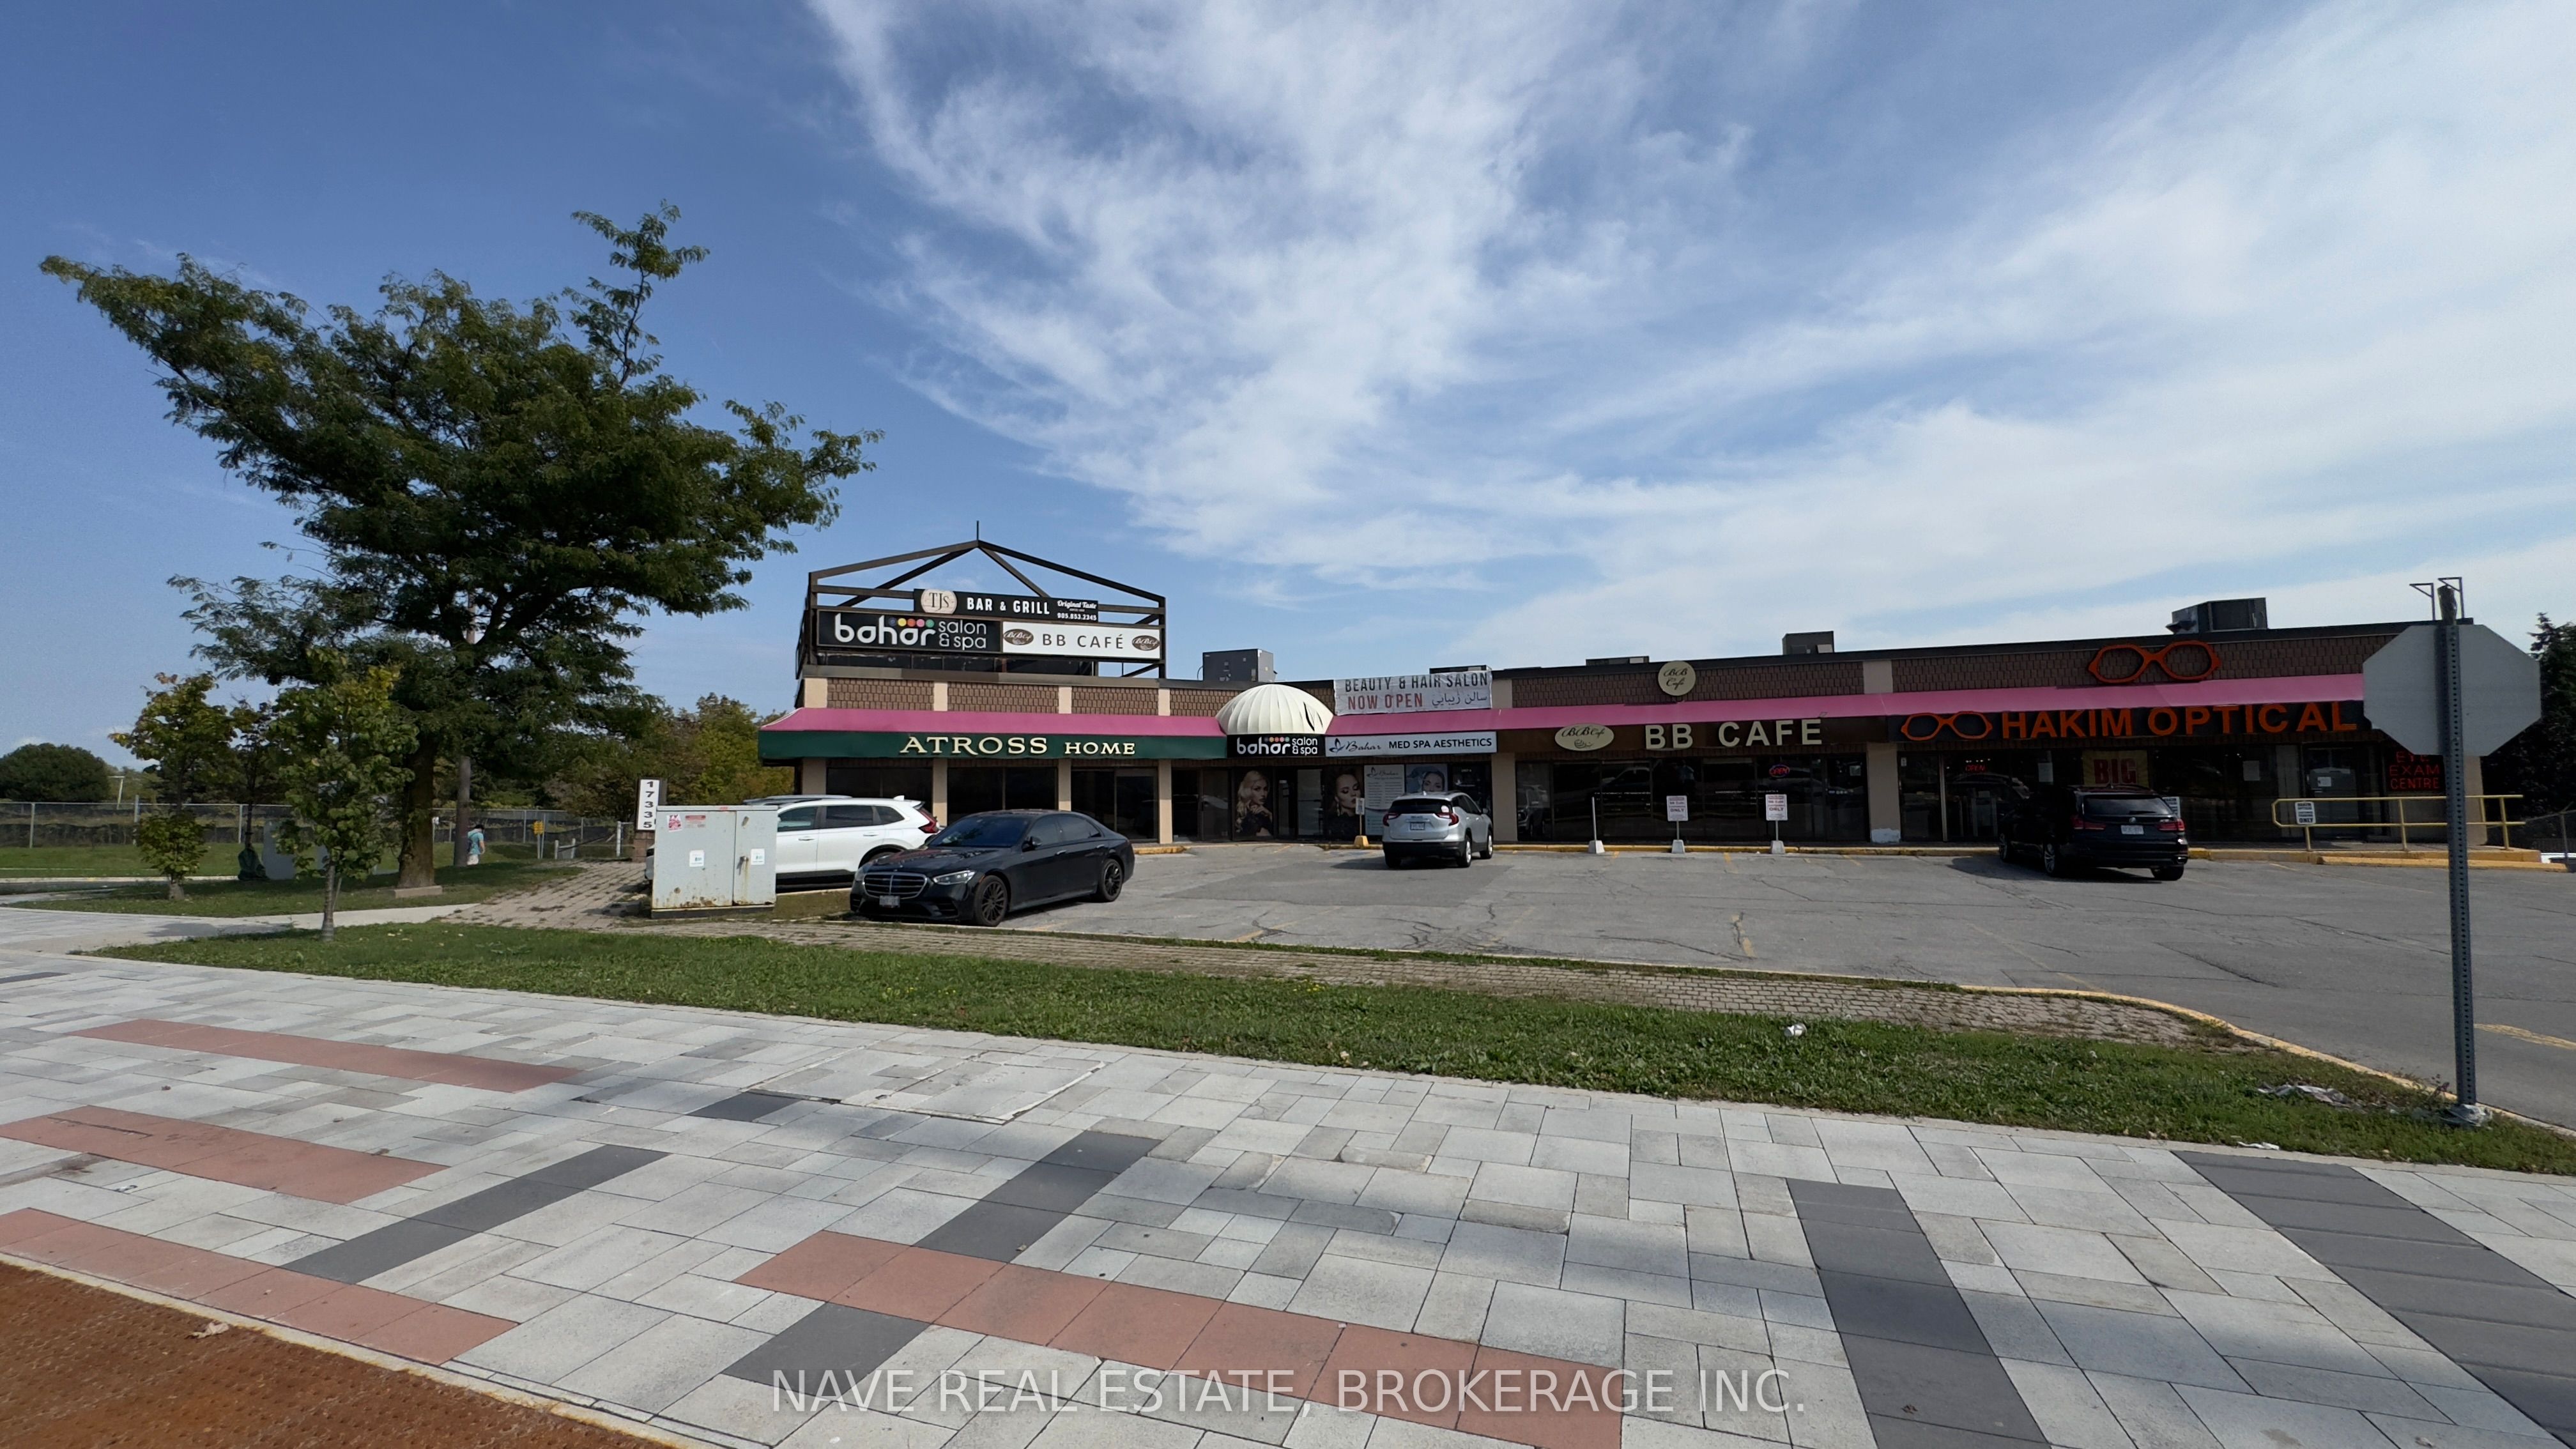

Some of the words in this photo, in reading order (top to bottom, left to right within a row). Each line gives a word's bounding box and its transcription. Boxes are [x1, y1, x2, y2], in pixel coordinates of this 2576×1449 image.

[967, 597, 993, 611] BAR
[1000, 601, 1006, 611] &
[1013, 599, 1050, 615] GRILL
[1057, 600, 1082, 609] Original
[835, 613, 936, 646] bahar
[938, 619, 986, 634] salon
[939, 632, 950, 647] &
[953, 636, 986, 650] spa
[1043, 633, 1066, 647] BB
[1077, 633, 1124, 649] CAFÉ
[1345, 677, 1392, 693] BEAUTY
[1399, 677, 1406, 689] &
[1411, 673, 1441, 689] HAIR
[1446, 672, 1488, 687] SALON
[1348, 694, 1378, 710] NOW
[1384, 693, 1423, 709] OPEN
[2002, 708, 2133, 739] HAKIM
[2147, 702, 2358, 736] OPTICAL
[1292, 737, 1318, 746] salon
[1645, 723, 1694, 750] BB
[1718, 719, 1823, 747] CAFE
[900, 736, 1048, 756] ATROSS
[1064, 742, 1136, 755] HOME
[1236, 736, 1291, 755] bahar
[1292, 744, 1299, 755] &
[1300, 746, 1318, 756] spa
[1345, 740, 1381, 752] Bahar
[1389, 740, 1411, 749] MED
[1413, 740, 1431, 749] SPA
[1434, 738, 1492, 748] AESTHETICS
[2093, 758, 2137, 784] BIG
[2389, 764, 2440, 776] EXAM
[2391, 777, 2441, 790] CENTRE
[643, 781, 655, 828] 17335
